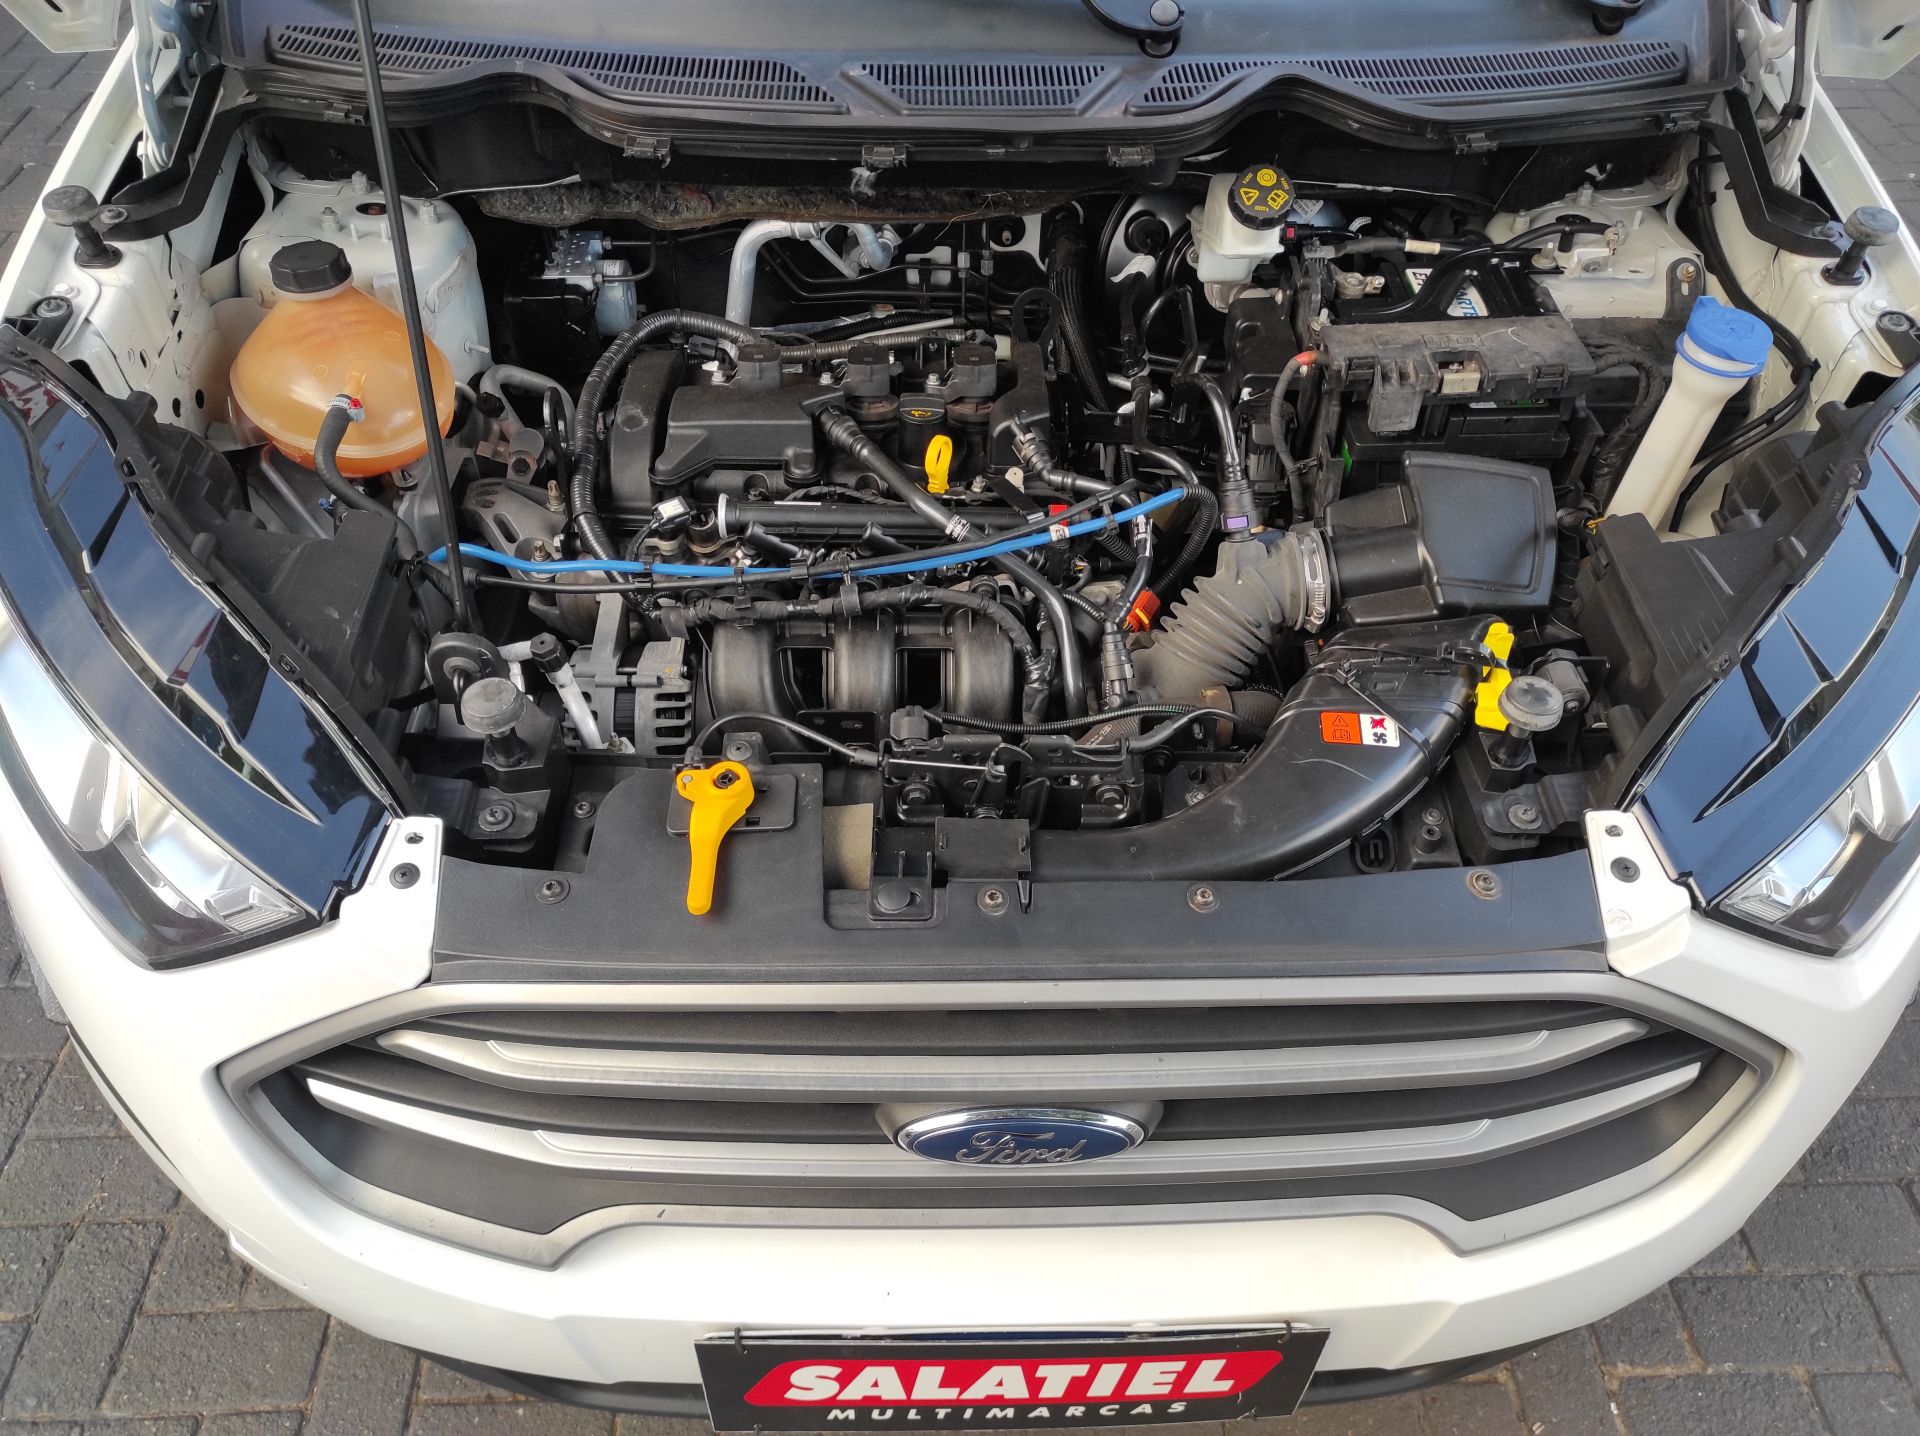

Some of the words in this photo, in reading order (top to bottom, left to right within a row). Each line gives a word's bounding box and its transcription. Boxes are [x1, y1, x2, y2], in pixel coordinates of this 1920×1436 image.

[956, 1130, 1087, 1164] Ford
[784, 1359, 1237, 1402] SALATIEL
[826, 1402, 1189, 1422] MULTIMARCAS
